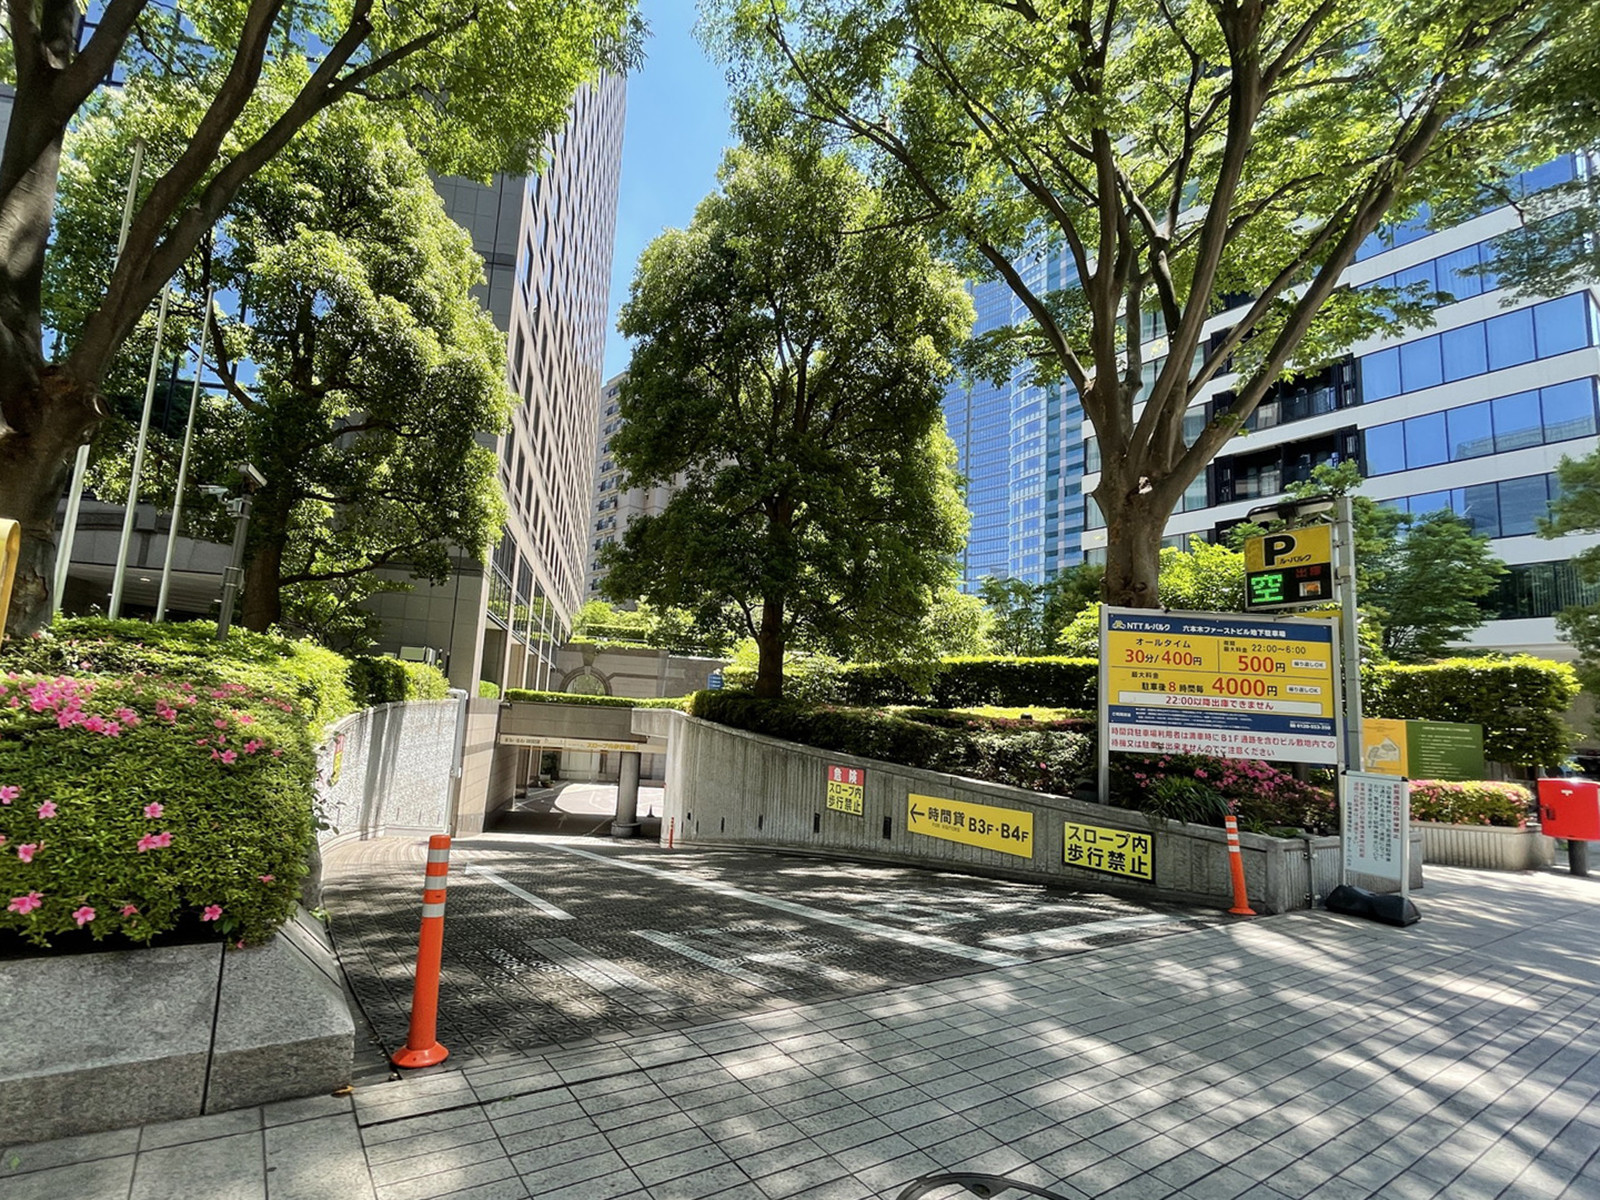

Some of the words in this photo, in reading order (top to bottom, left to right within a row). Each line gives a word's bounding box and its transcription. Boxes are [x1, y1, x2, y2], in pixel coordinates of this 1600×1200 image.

[1264, 534, 1296, 567] P
[1251, 574, 1283, 603] 空
[1127, 622, 1143, 630] NTT
[1136, 638, 1191, 648] オールタイム
[1238, 655, 1286, 673] 500円
[1211, 677, 1278, 697] 4000円
[1165, 695, 1274, 710] 22:00以降出庫できません
[834, 767, 858, 784] 危険
[829, 782, 862, 799] スロープ内
[828, 795, 861, 813] 歩行禁止
[928, 807, 965, 828] 時間貸
[1068, 825, 1148, 855] スロープ内
[1067, 843, 1149, 877] 歩行禁止
